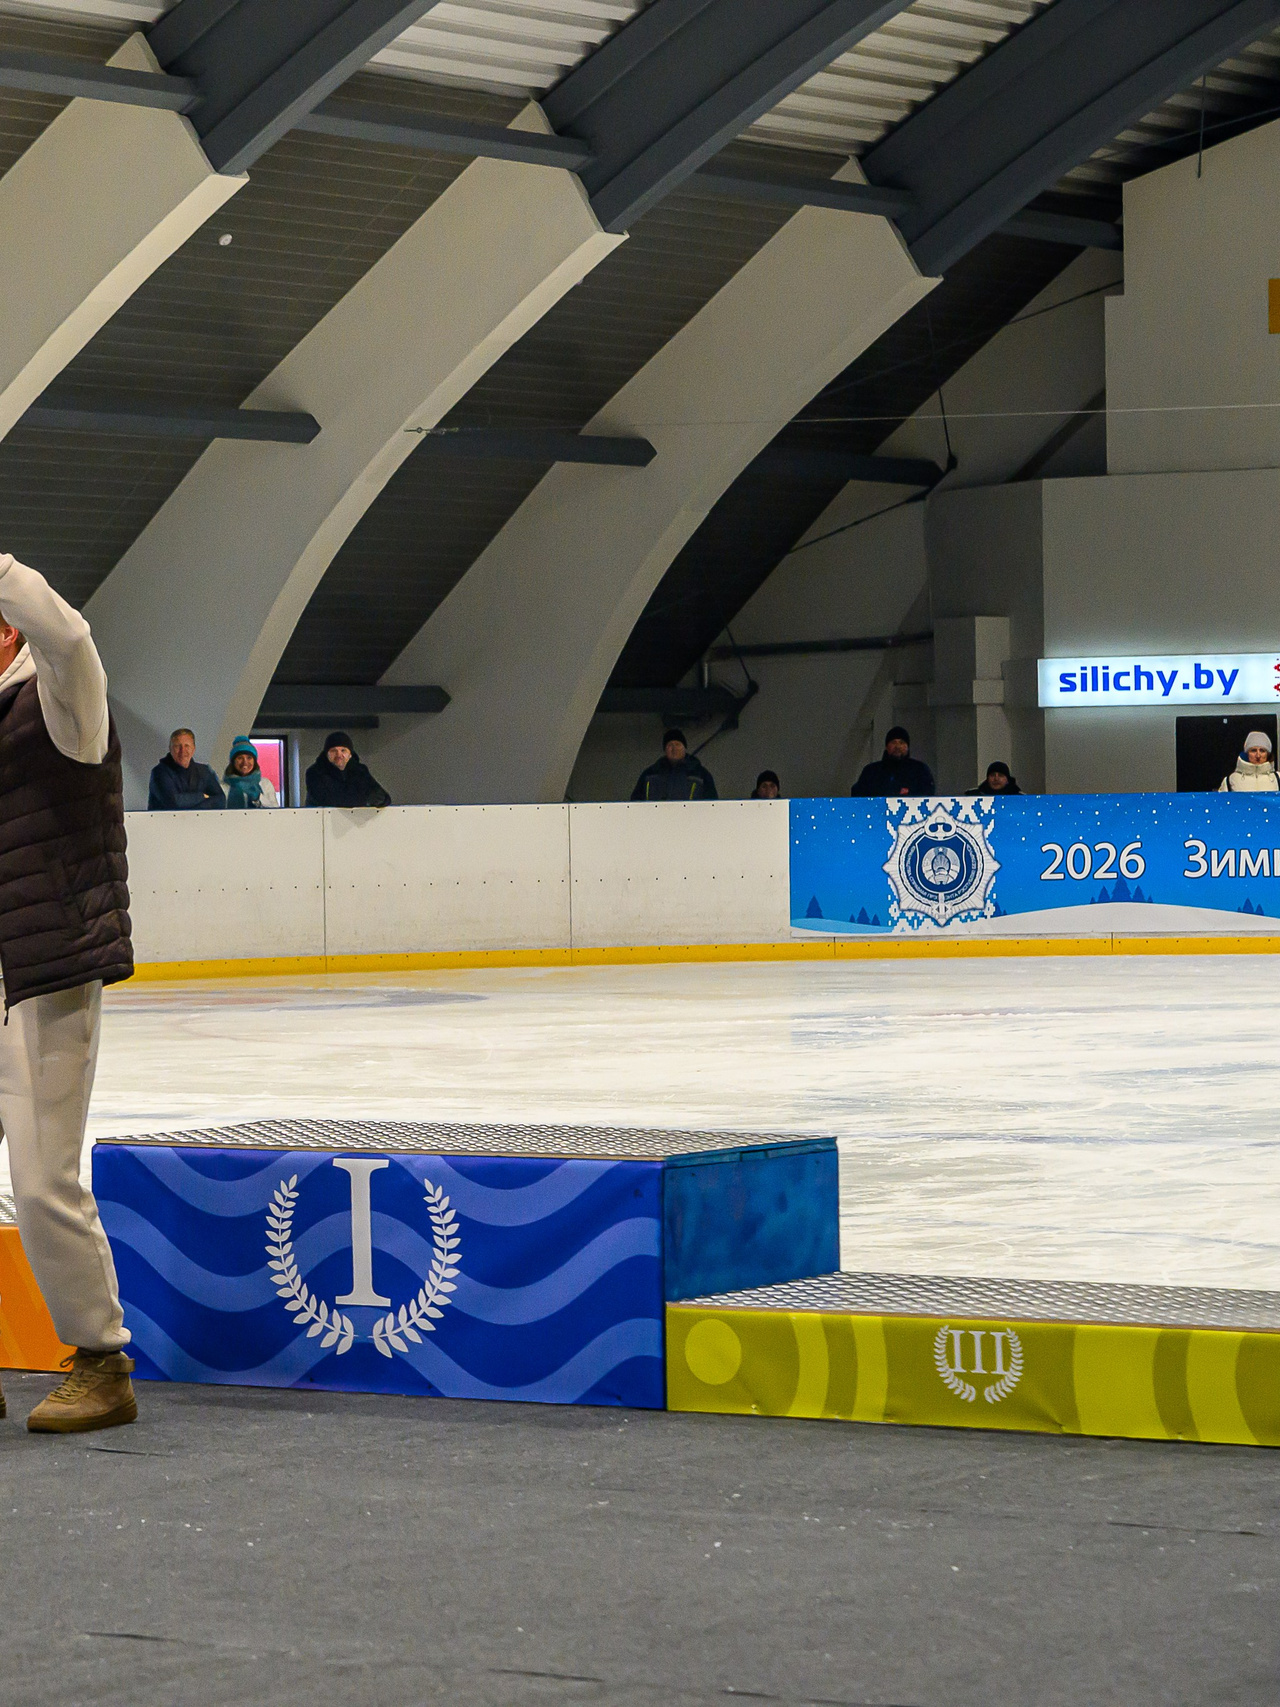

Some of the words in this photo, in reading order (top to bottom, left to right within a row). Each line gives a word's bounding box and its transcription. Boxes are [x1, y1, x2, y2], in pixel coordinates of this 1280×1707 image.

[1058, 662, 1240, 697] silichy.by
[1039, 840, 1147, 881] 2026
[1183, 838, 1280, 880] Зим
[332, 1157, 392, 1308] I
[948, 1329, 1010, 1375] III
